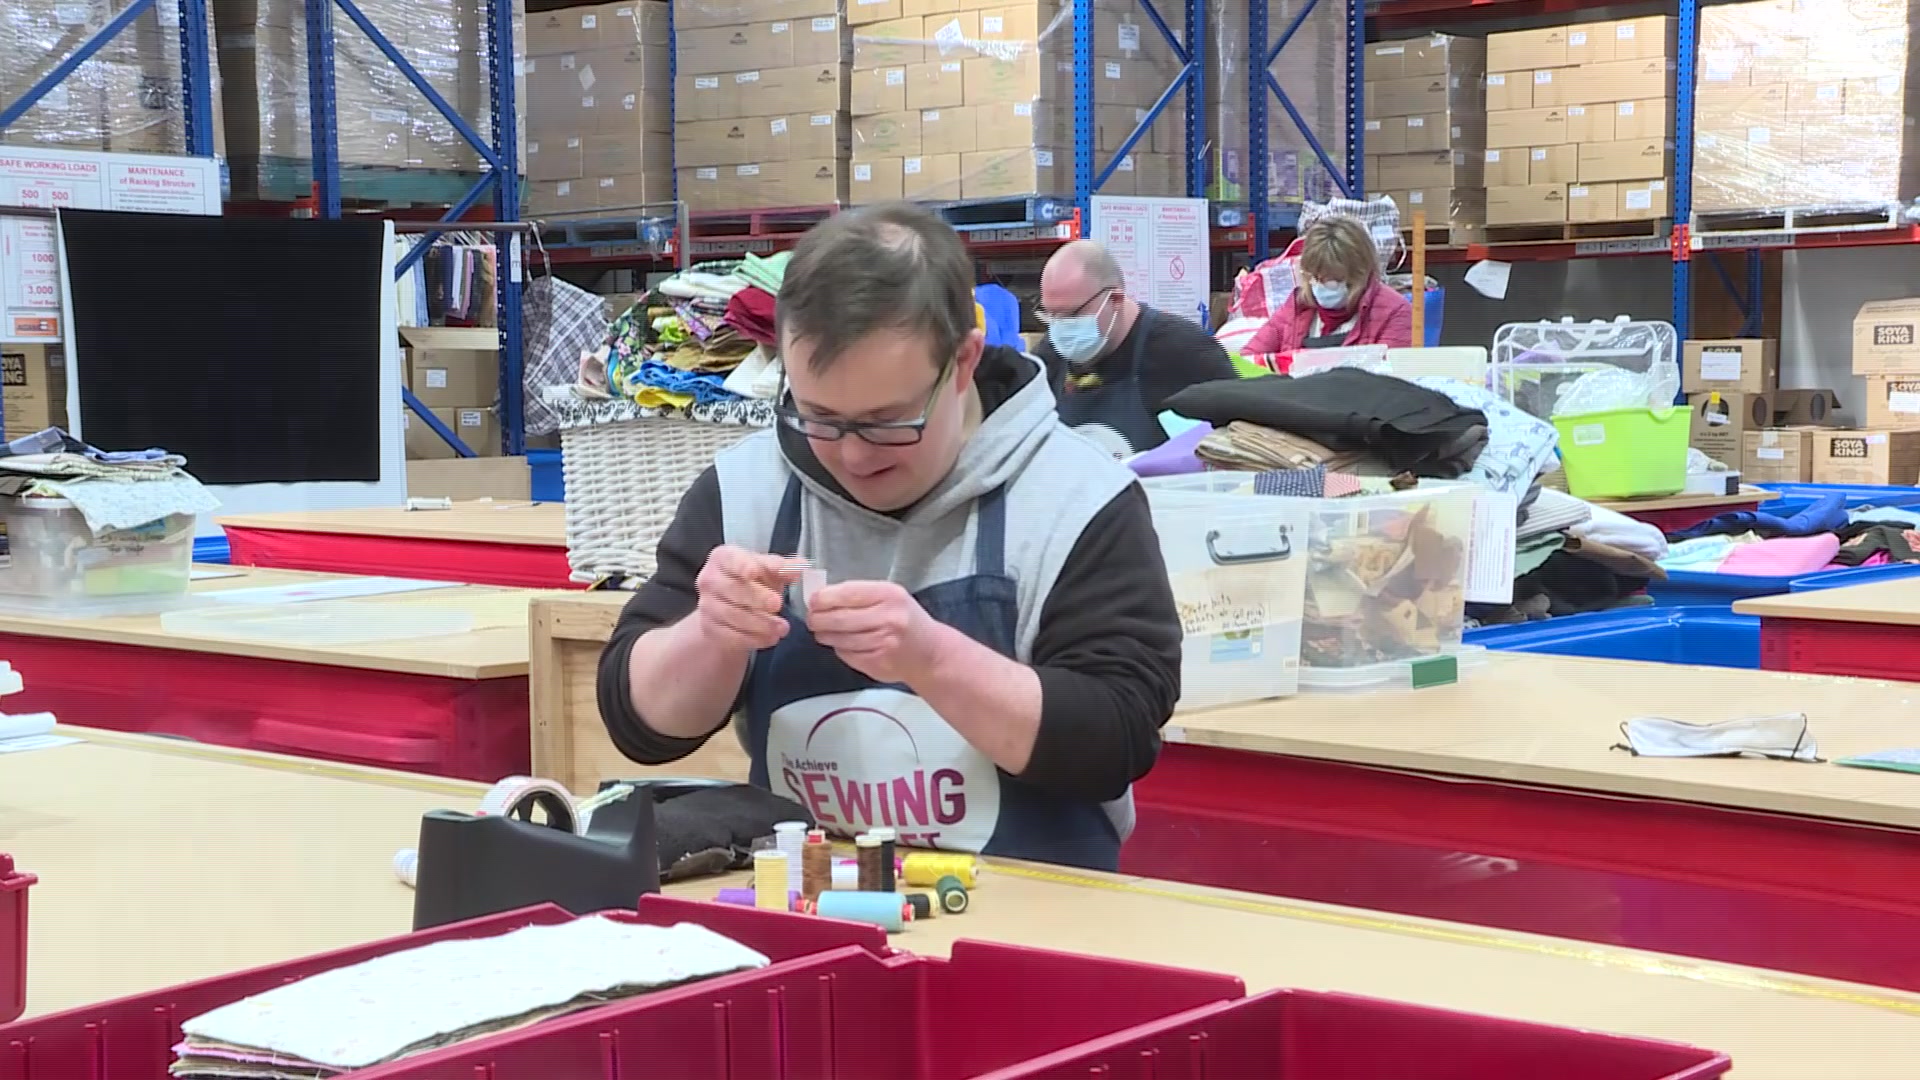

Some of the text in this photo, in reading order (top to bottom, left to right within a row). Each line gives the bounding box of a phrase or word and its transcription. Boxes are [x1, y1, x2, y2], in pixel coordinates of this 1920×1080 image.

[0, 159, 22, 168] SAFE
[24, 161, 67, 171] WORKING
[67, 163, 97, 173] LOADS
[127, 166, 185, 177] MAINTENANCE
[119, 177, 196, 188] of Racking Structure
[21, 189, 69, 201] 500 500
[32, 253, 55, 263] 1000
[28, 285, 54, 296] 3,000
[1877, 327, 1910, 336] SOYA
[1877, 335, 1910, 345] KING
[1834, 440, 1864, 449] SOYA
[1834, 448, 1865, 457] KING
[795, 758, 838, 771] Achieve
[782, 768, 966, 826] SEWING
